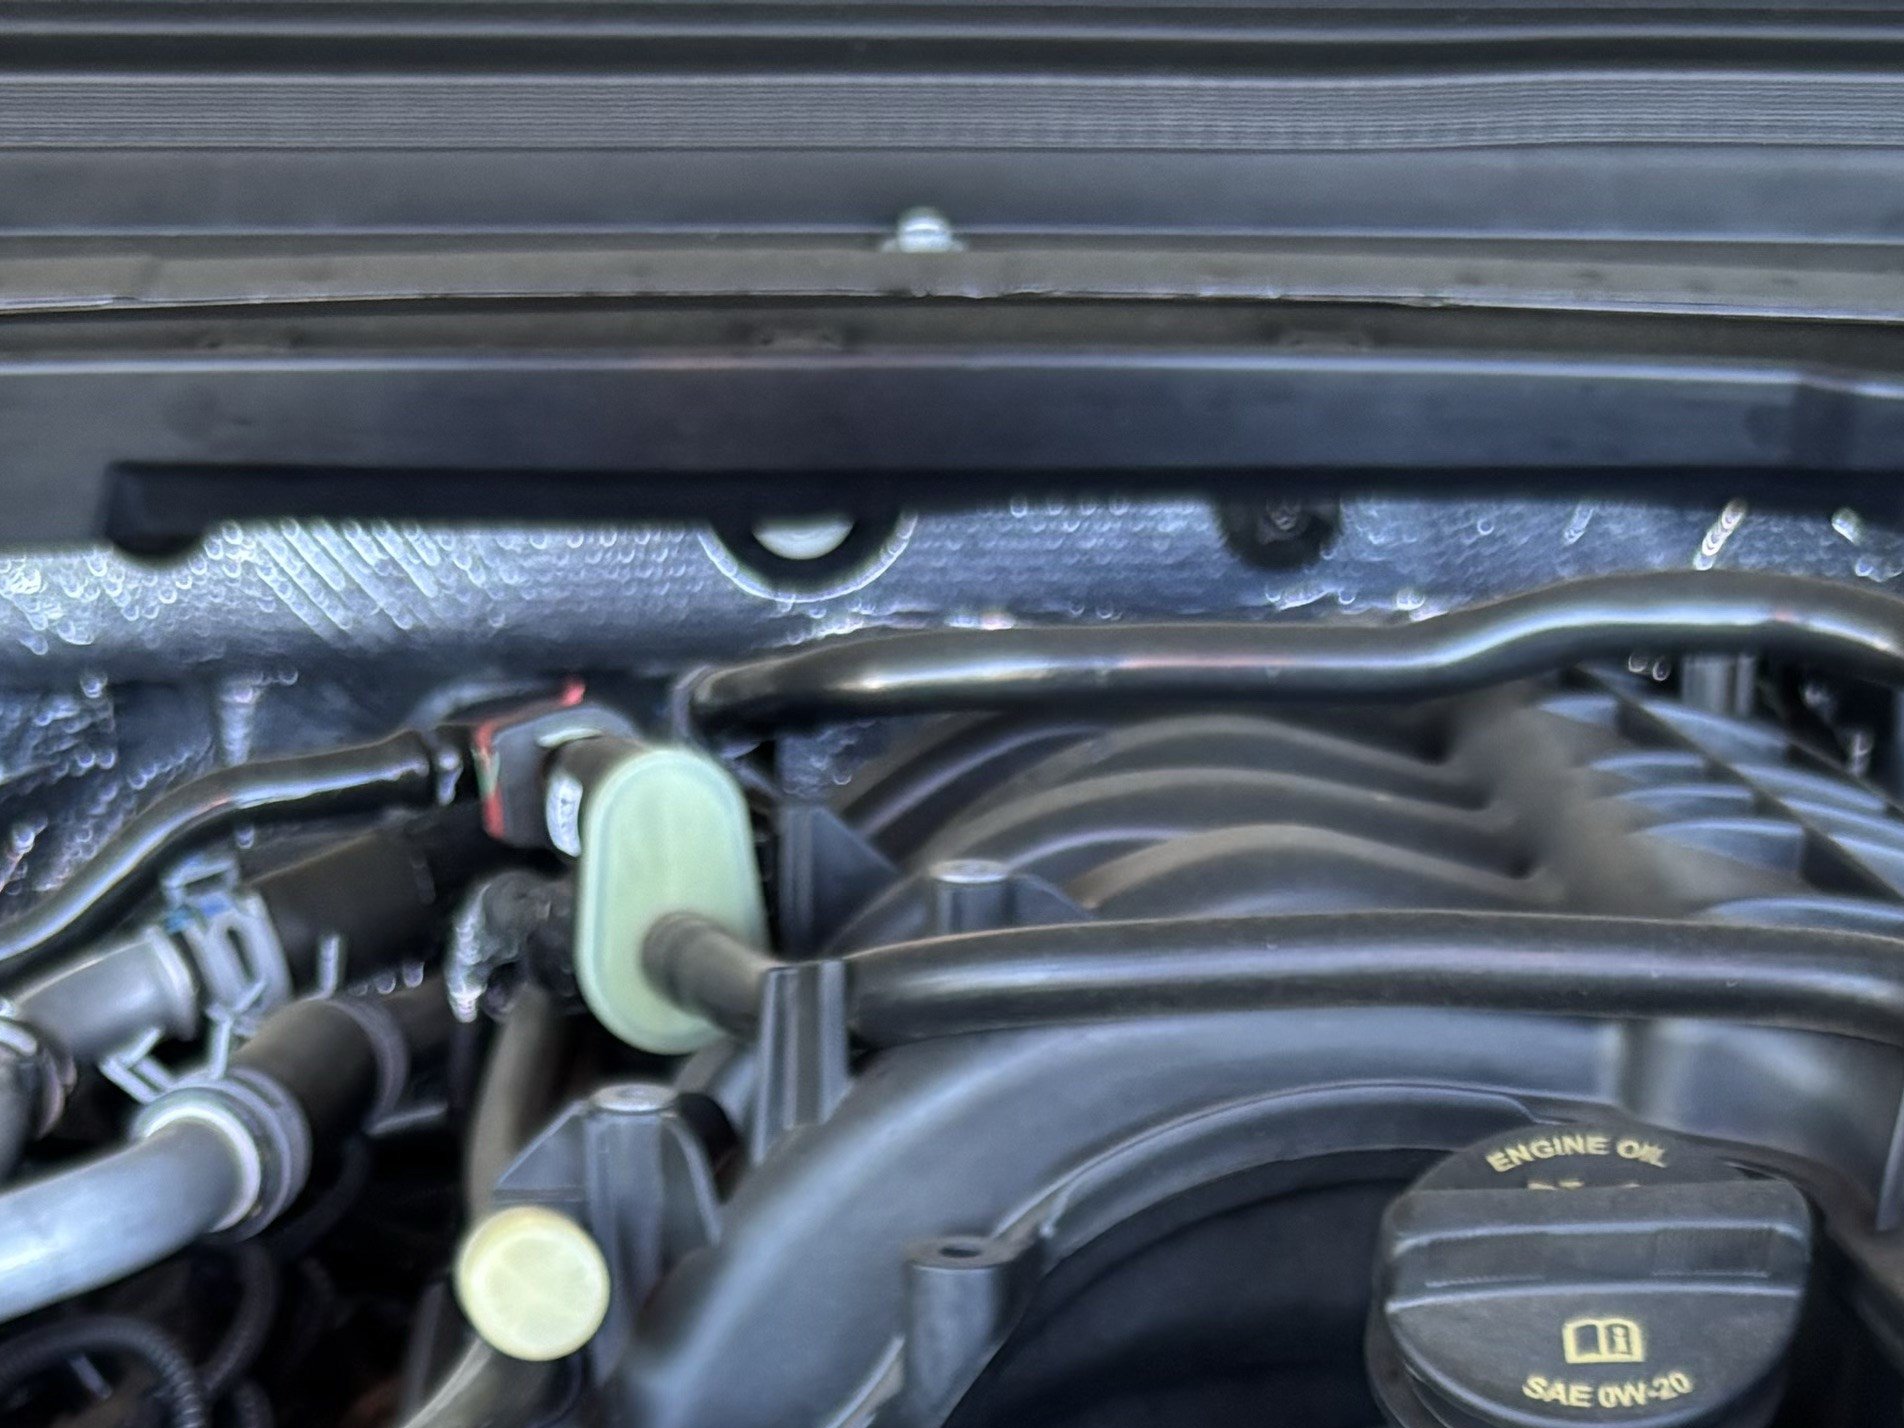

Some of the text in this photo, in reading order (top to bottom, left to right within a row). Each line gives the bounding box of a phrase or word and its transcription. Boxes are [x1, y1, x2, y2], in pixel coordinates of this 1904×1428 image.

[1485, 1134, 1667, 1173] ENGINE OIL
[1522, 1370, 1694, 1409] SAE 0W-20
